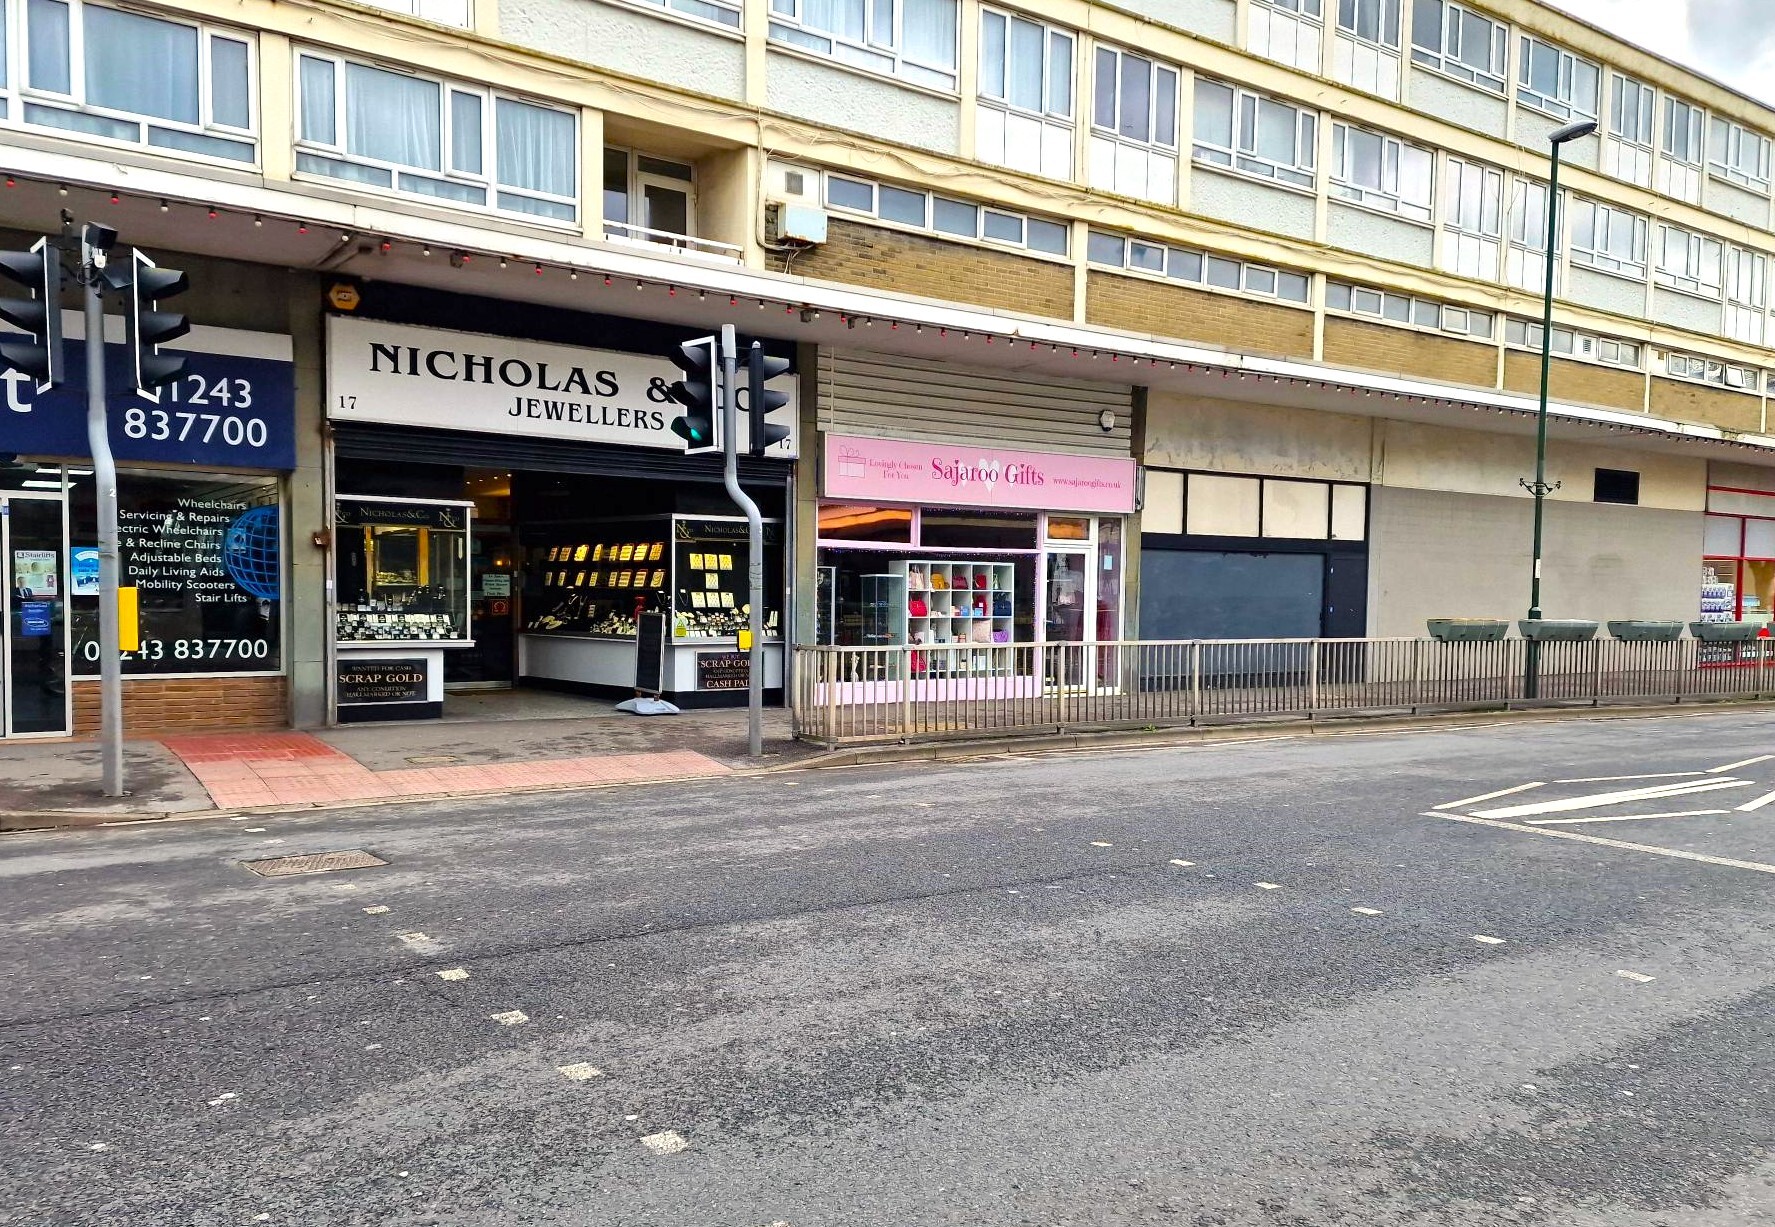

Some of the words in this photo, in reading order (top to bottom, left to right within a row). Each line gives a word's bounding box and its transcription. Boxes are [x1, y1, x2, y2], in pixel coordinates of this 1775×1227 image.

[369, 342, 619, 398] NICHOLAS
[646, 376, 678, 405] &
[155, 374, 253, 409] 1243
[339, 395, 357, 410] 17
[508, 397, 665, 431] JEWELLERS
[124, 407, 268, 448] 837700
[779, 438, 792, 450] 17
[869, 459, 896, 471] Lovingly
[898, 460, 923, 471] Chosen
[896, 470, 910, 480] You
[931, 457, 999, 487] Sajaroo
[1004, 463, 1045, 486] Gifts
[177, 498, 248, 510] Wheelchairs
[119, 509, 173, 521] Servicing
[176, 512, 186, 521] &
[189, 513, 231, 524] Repairs
[117, 524, 149, 534] ectric
[152, 525, 223, 537] Wheelchairs
[126, 538, 135, 547] &
[139, 539, 181, 549] Recline
[184, 539, 221, 550] Chairs
[130, 552, 191, 564] Adjustable
[195, 554, 222, 563] Beds
[128, 566, 158, 577] Daily
[162, 566, 196, 579] Living
[199, 567, 225, 577] Aids
[135, 579, 182, 591] Mobility
[186, 580, 236, 590] Scooters
[195, 593, 221, 603] Stair
[224, 594, 248, 603] Lifts
[84, 640, 163, 662] 043
[174, 639, 268, 660] 837700
[700, 660, 731, 668] SCRAP
[339, 674, 382, 684] SCRAP
[386, 673, 423, 683] GOLD
[706, 680, 731, 689] CASH
[734, 679, 749, 688] PAI
